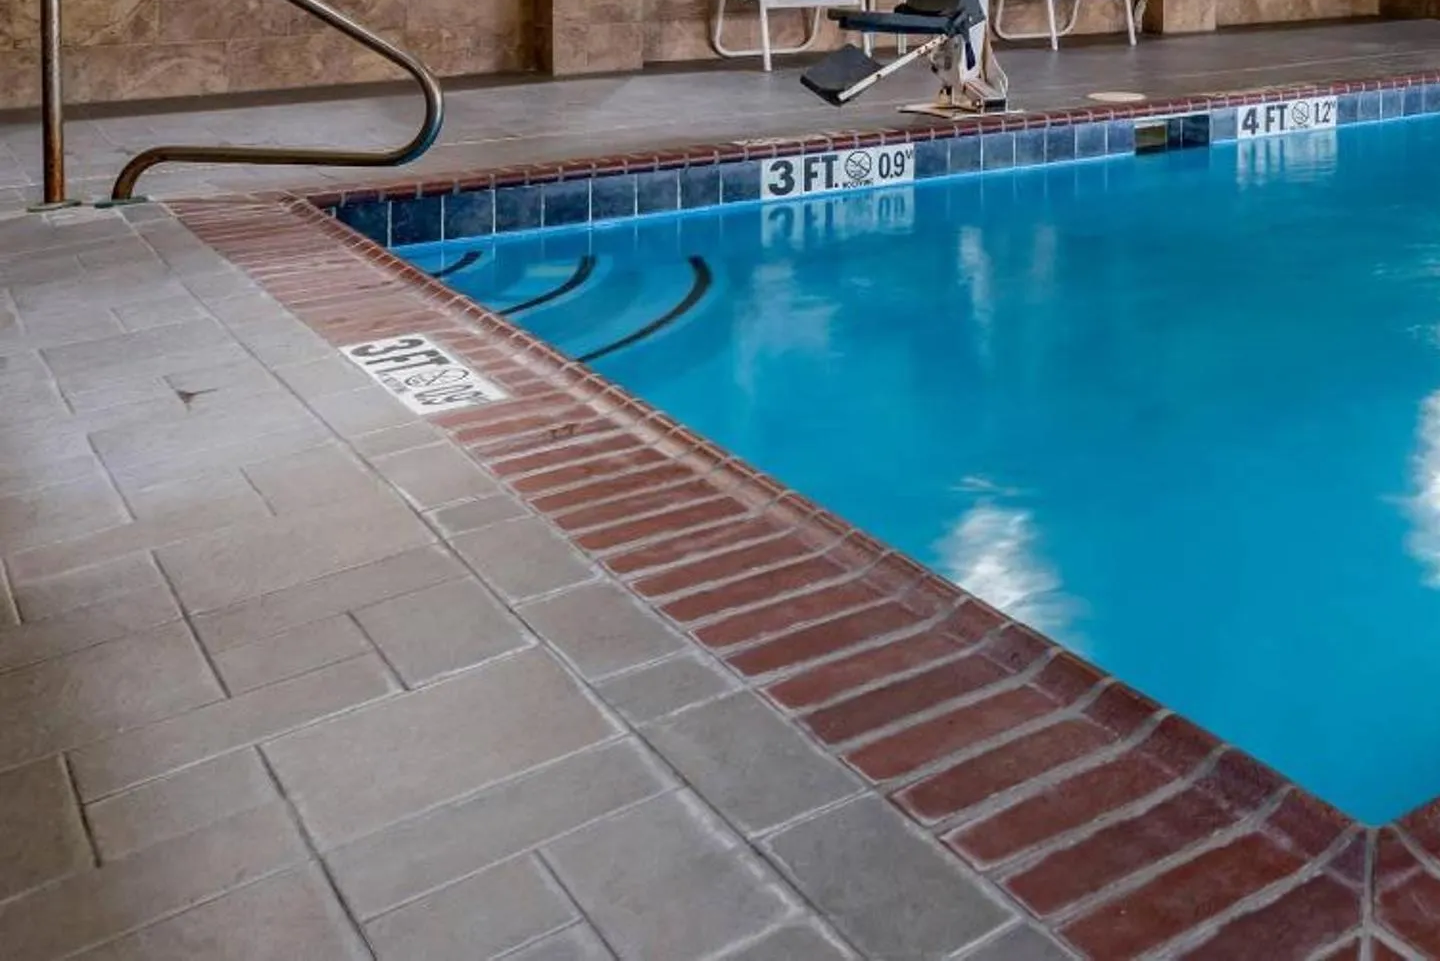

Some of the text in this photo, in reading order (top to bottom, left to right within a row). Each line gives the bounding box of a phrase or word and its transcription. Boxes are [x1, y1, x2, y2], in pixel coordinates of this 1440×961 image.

[1242, 108, 1259, 135] 4
[768, 160, 795, 196] 3
[351, 339, 424, 356] 3
